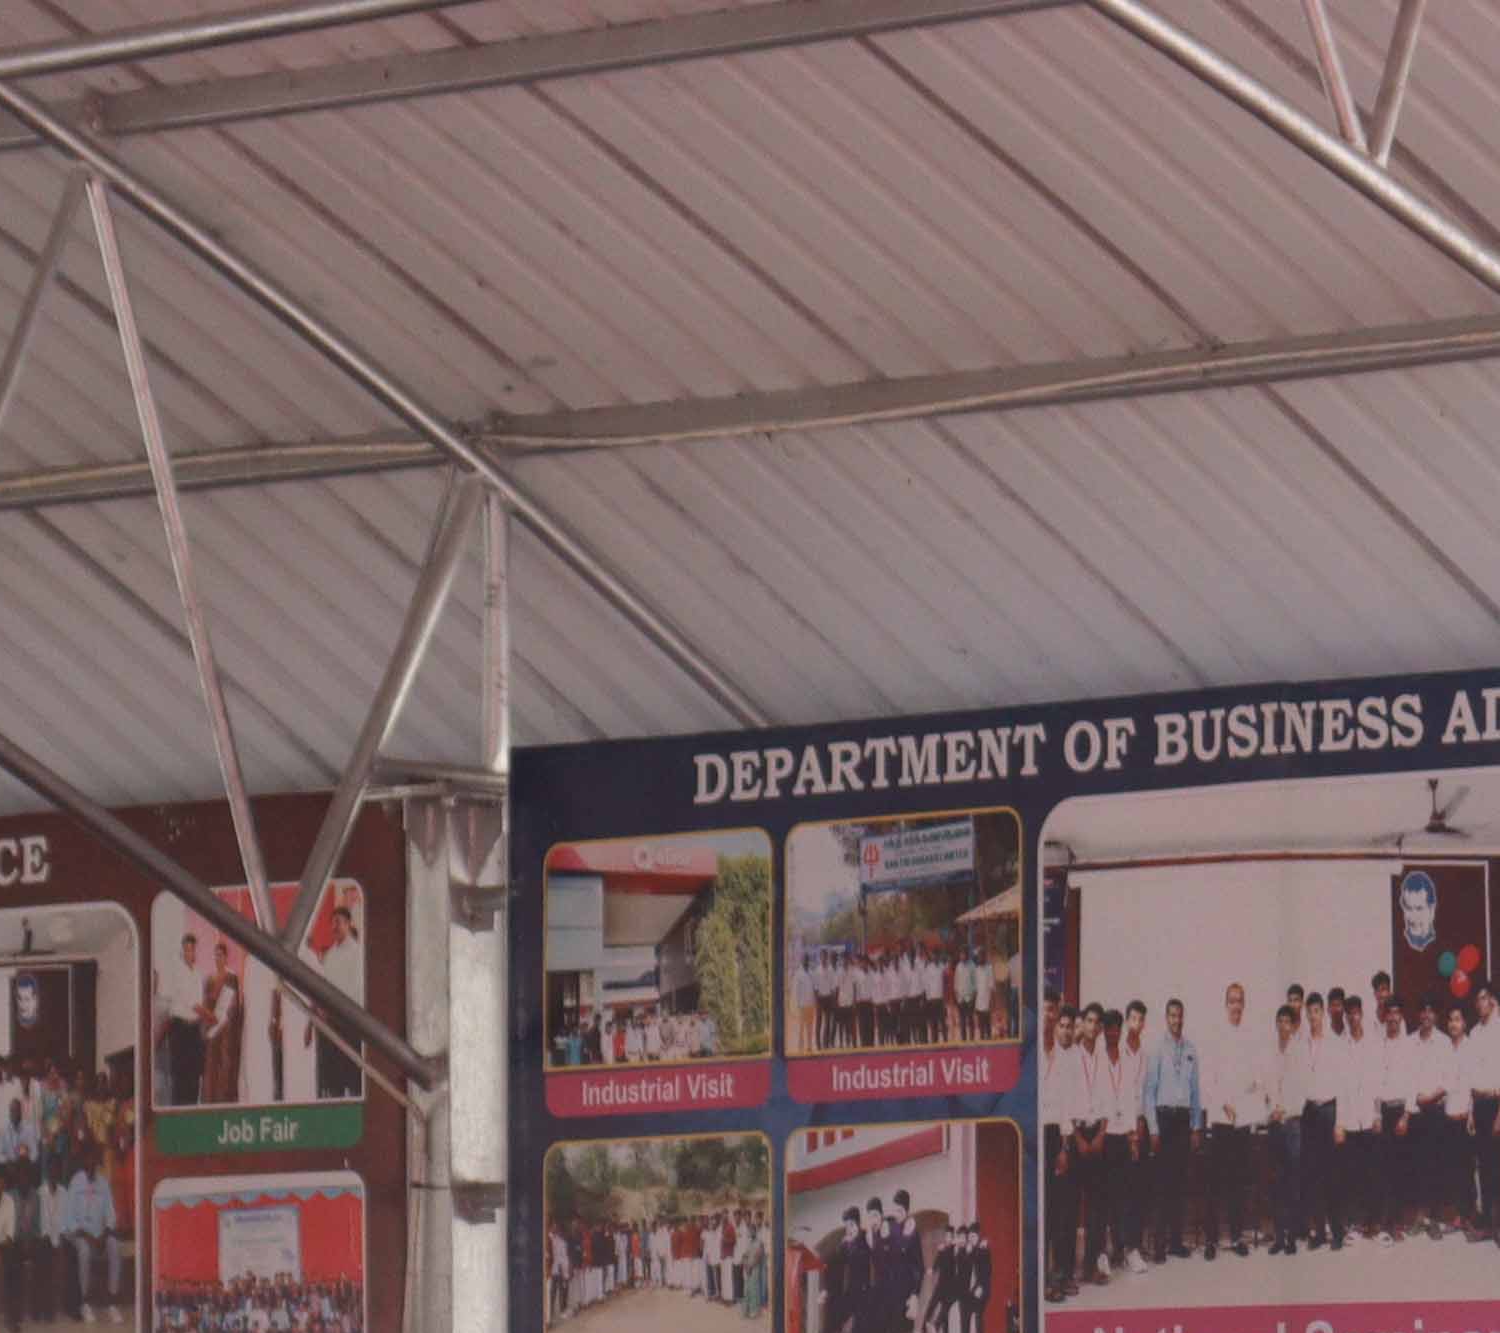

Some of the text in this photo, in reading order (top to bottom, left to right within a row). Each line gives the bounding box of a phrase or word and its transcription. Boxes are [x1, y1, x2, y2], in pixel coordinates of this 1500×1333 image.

[694, 725, 1047, 805] DEPARTMENT
[1063, 718, 1137, 772] OF
[1154, 695, 1424, 768] BUSINESS
[831, 1057, 990, 1090] Industrial Visit
[581, 1074, 734, 1106] Industrial Visit
[218, 1117, 299, 1145] Job Fair
